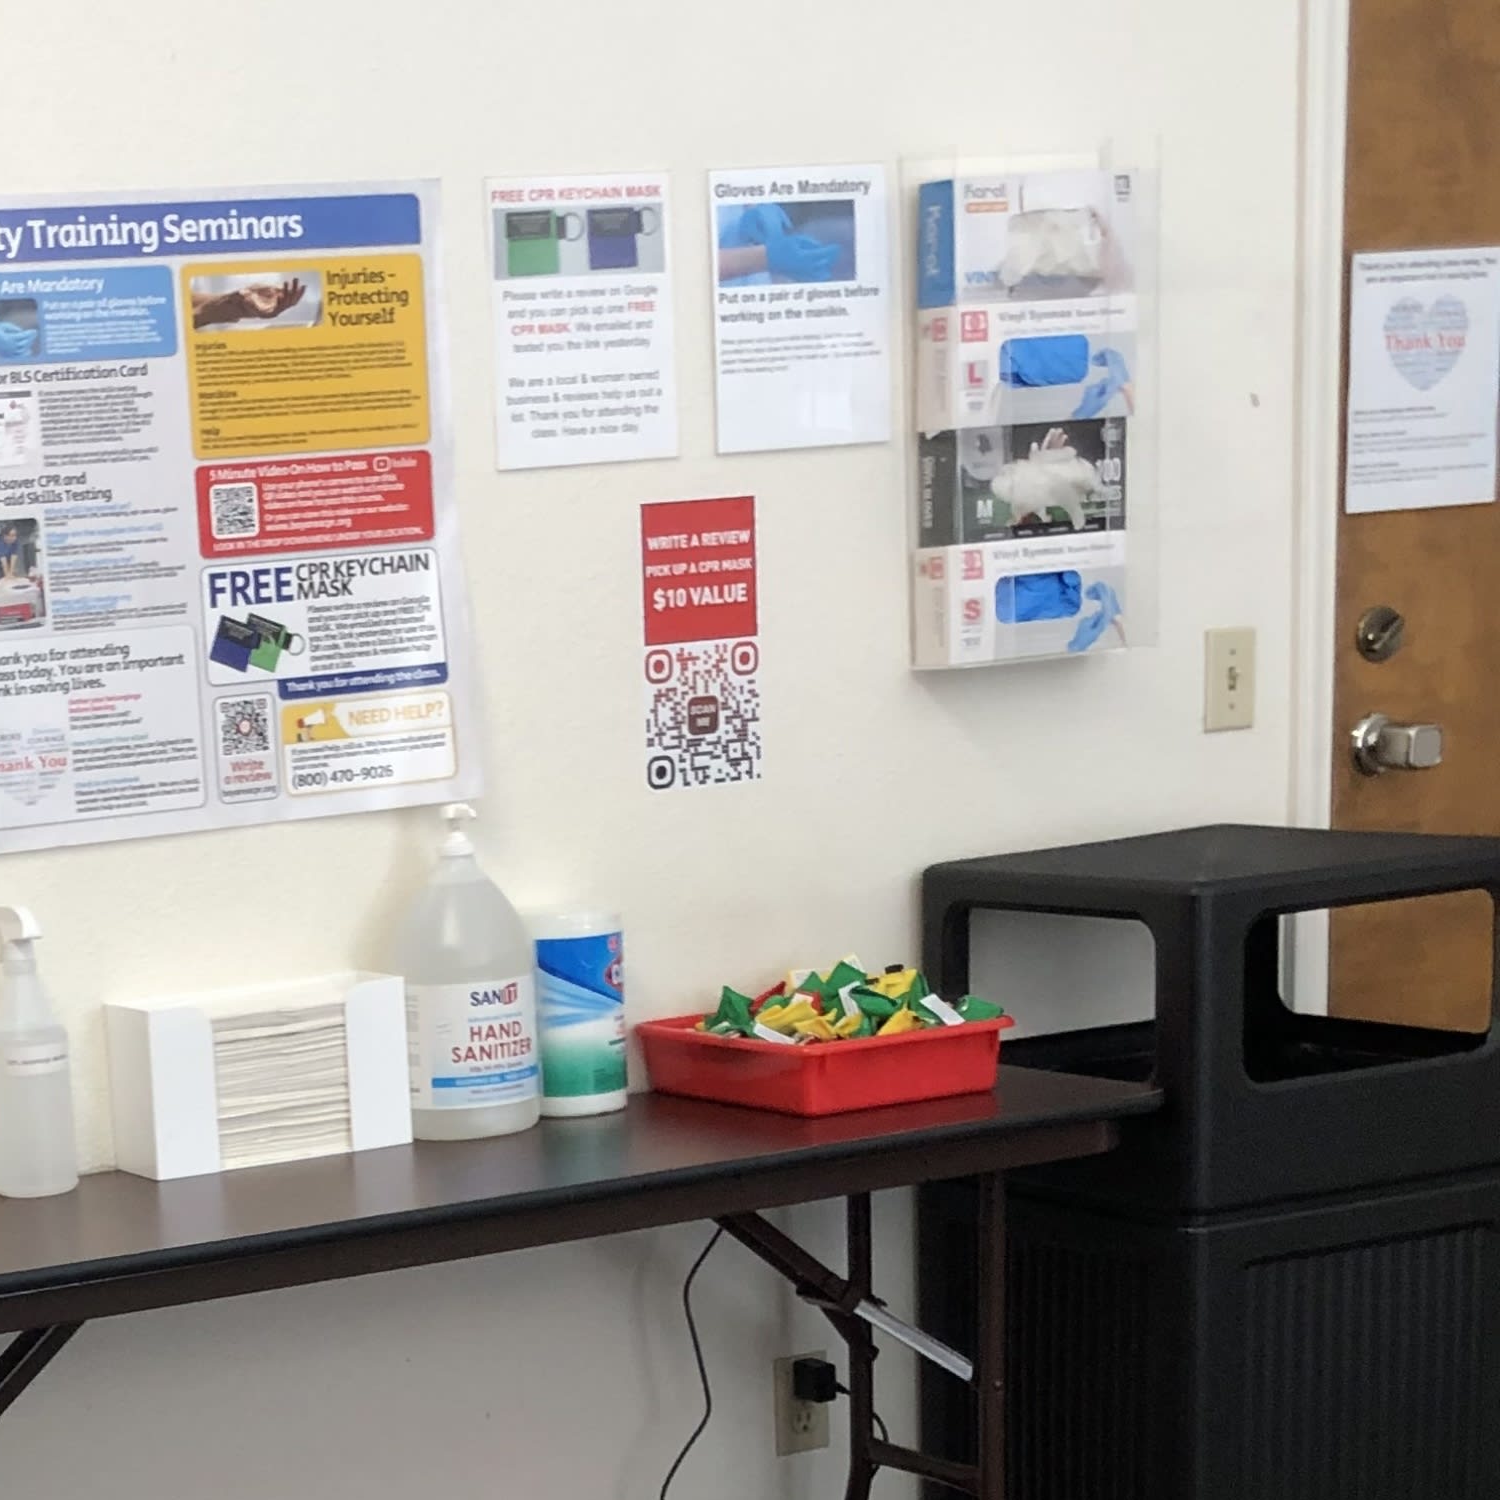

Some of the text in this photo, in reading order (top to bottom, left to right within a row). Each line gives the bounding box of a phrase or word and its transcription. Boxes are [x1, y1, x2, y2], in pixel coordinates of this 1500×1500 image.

[491, 186, 661, 202] FREE CPR KEYCHAIN MASK
[714, 179, 871, 198] Gloves Are Mandatory
[27, 216, 158, 253] Training
[163, 211, 304, 242] Seminars
[0, 280, 26, 295] Are
[25, 278, 104, 298] Mandatory
[326, 268, 385, 288] Injuries
[327, 289, 410, 310] Protecting
[502, 290, 537, 302] Please
[539, 288, 564, 300] write
[573, 287, 607, 298] review
[623, 284, 658, 299] Google
[718, 293, 738, 304] Put
[740, 295, 756, 303] on
[767, 291, 789, 304] pair
[792, 290, 804, 300] of
[806, 288, 842, 302] gloves
[843, 286, 880, 298] before
[328, 308, 396, 327] Yourself
[508, 301, 656, 320] and you can pick up one FREE
[720, 306, 849, 326] working on the manikin.
[1384, 331, 1466, 352] Thank You
[9, 371, 31, 384] BLS
[32, 366, 119, 382] Certification
[118, 364, 148, 377] Card
[968, 362, 983, 384] L
[37, 475, 62, 489] CPR
[61, 473, 86, 487] and
[215, 467, 258, 480] Minute
[256, 466, 290, 477] Video
[288, 465, 308, 475] On
[307, 463, 332, 474] How
[330, 463, 344, 473] to
[343, 462, 368, 472] Pass
[25, 491, 62, 505] Skills
[65, 488, 112, 505] Testing
[976, 498, 993, 519] M
[646, 529, 751, 551] WRITE A REVIEW
[296, 554, 430, 582] CPR KEYCHAIN
[645, 558, 752, 578] PICK UP A CPR MASK
[208, 568, 294, 608] FREE
[296, 579, 353, 600] MASK
[652, 584, 748, 613] $10 VALUE
[963, 599, 981, 620] S
[22, 654, 48, 667] you
[47, 650, 67, 662] for
[68, 645, 130, 664] attending
[17, 666, 54, 683] today.
[59, 663, 84, 677] You
[83, 664, 104, 674] are
[104, 663, 122, 673] an
[121, 655, 184, 674] important
[13, 683, 29, 696] in
[28, 680, 70, 698] saving
[71, 678, 106, 691] lives.
[286, 669, 441, 692] Thank you for attending the class.
[348, 702, 444, 726] NEED HELP?
[689, 703, 716, 716] SCAN
[39, 756, 68, 769] You
[230, 760, 264, 772] Write
[231, 772, 272, 784] review
[292, 765, 394, 788] (800) 470-9026
[470, 1021, 522, 1042] HAND
[451, 1037, 532, 1064] SANITIZER
